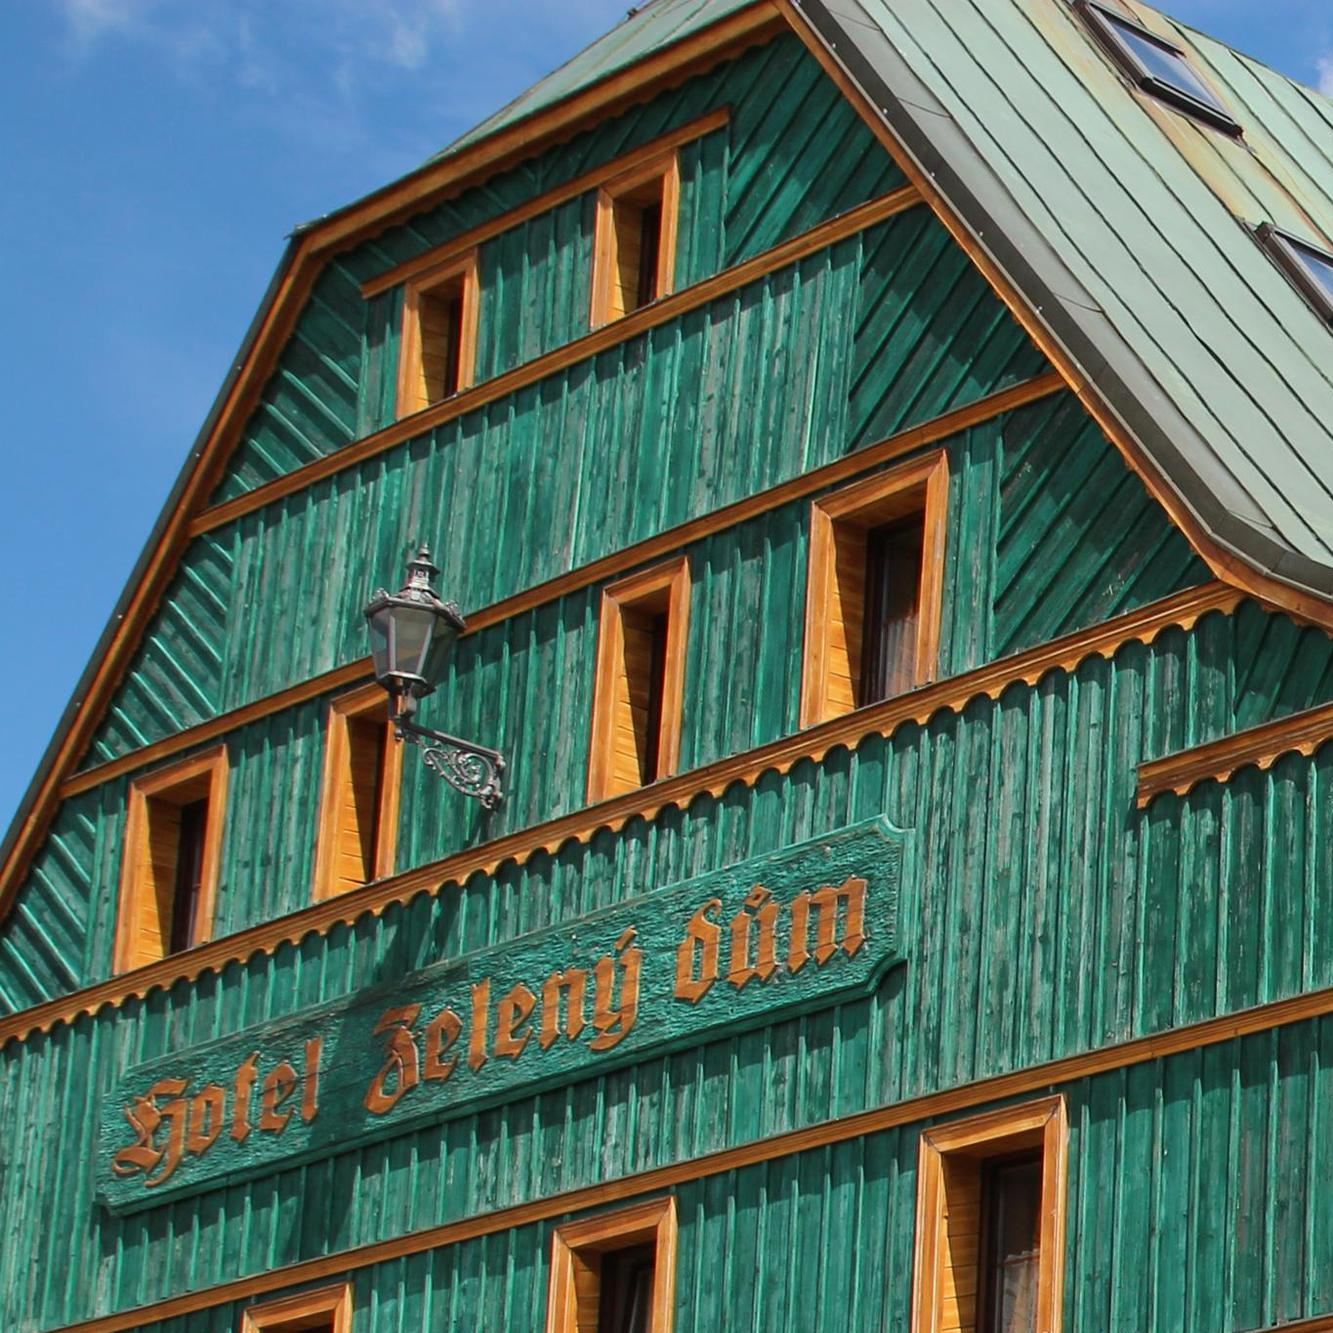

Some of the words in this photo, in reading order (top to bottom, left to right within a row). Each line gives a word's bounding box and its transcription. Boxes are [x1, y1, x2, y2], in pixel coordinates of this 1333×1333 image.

[113, 1036, 320, 1187] Hotel
[364, 924, 642, 1115] Zelený
[674, 875, 869, 1005] dům
